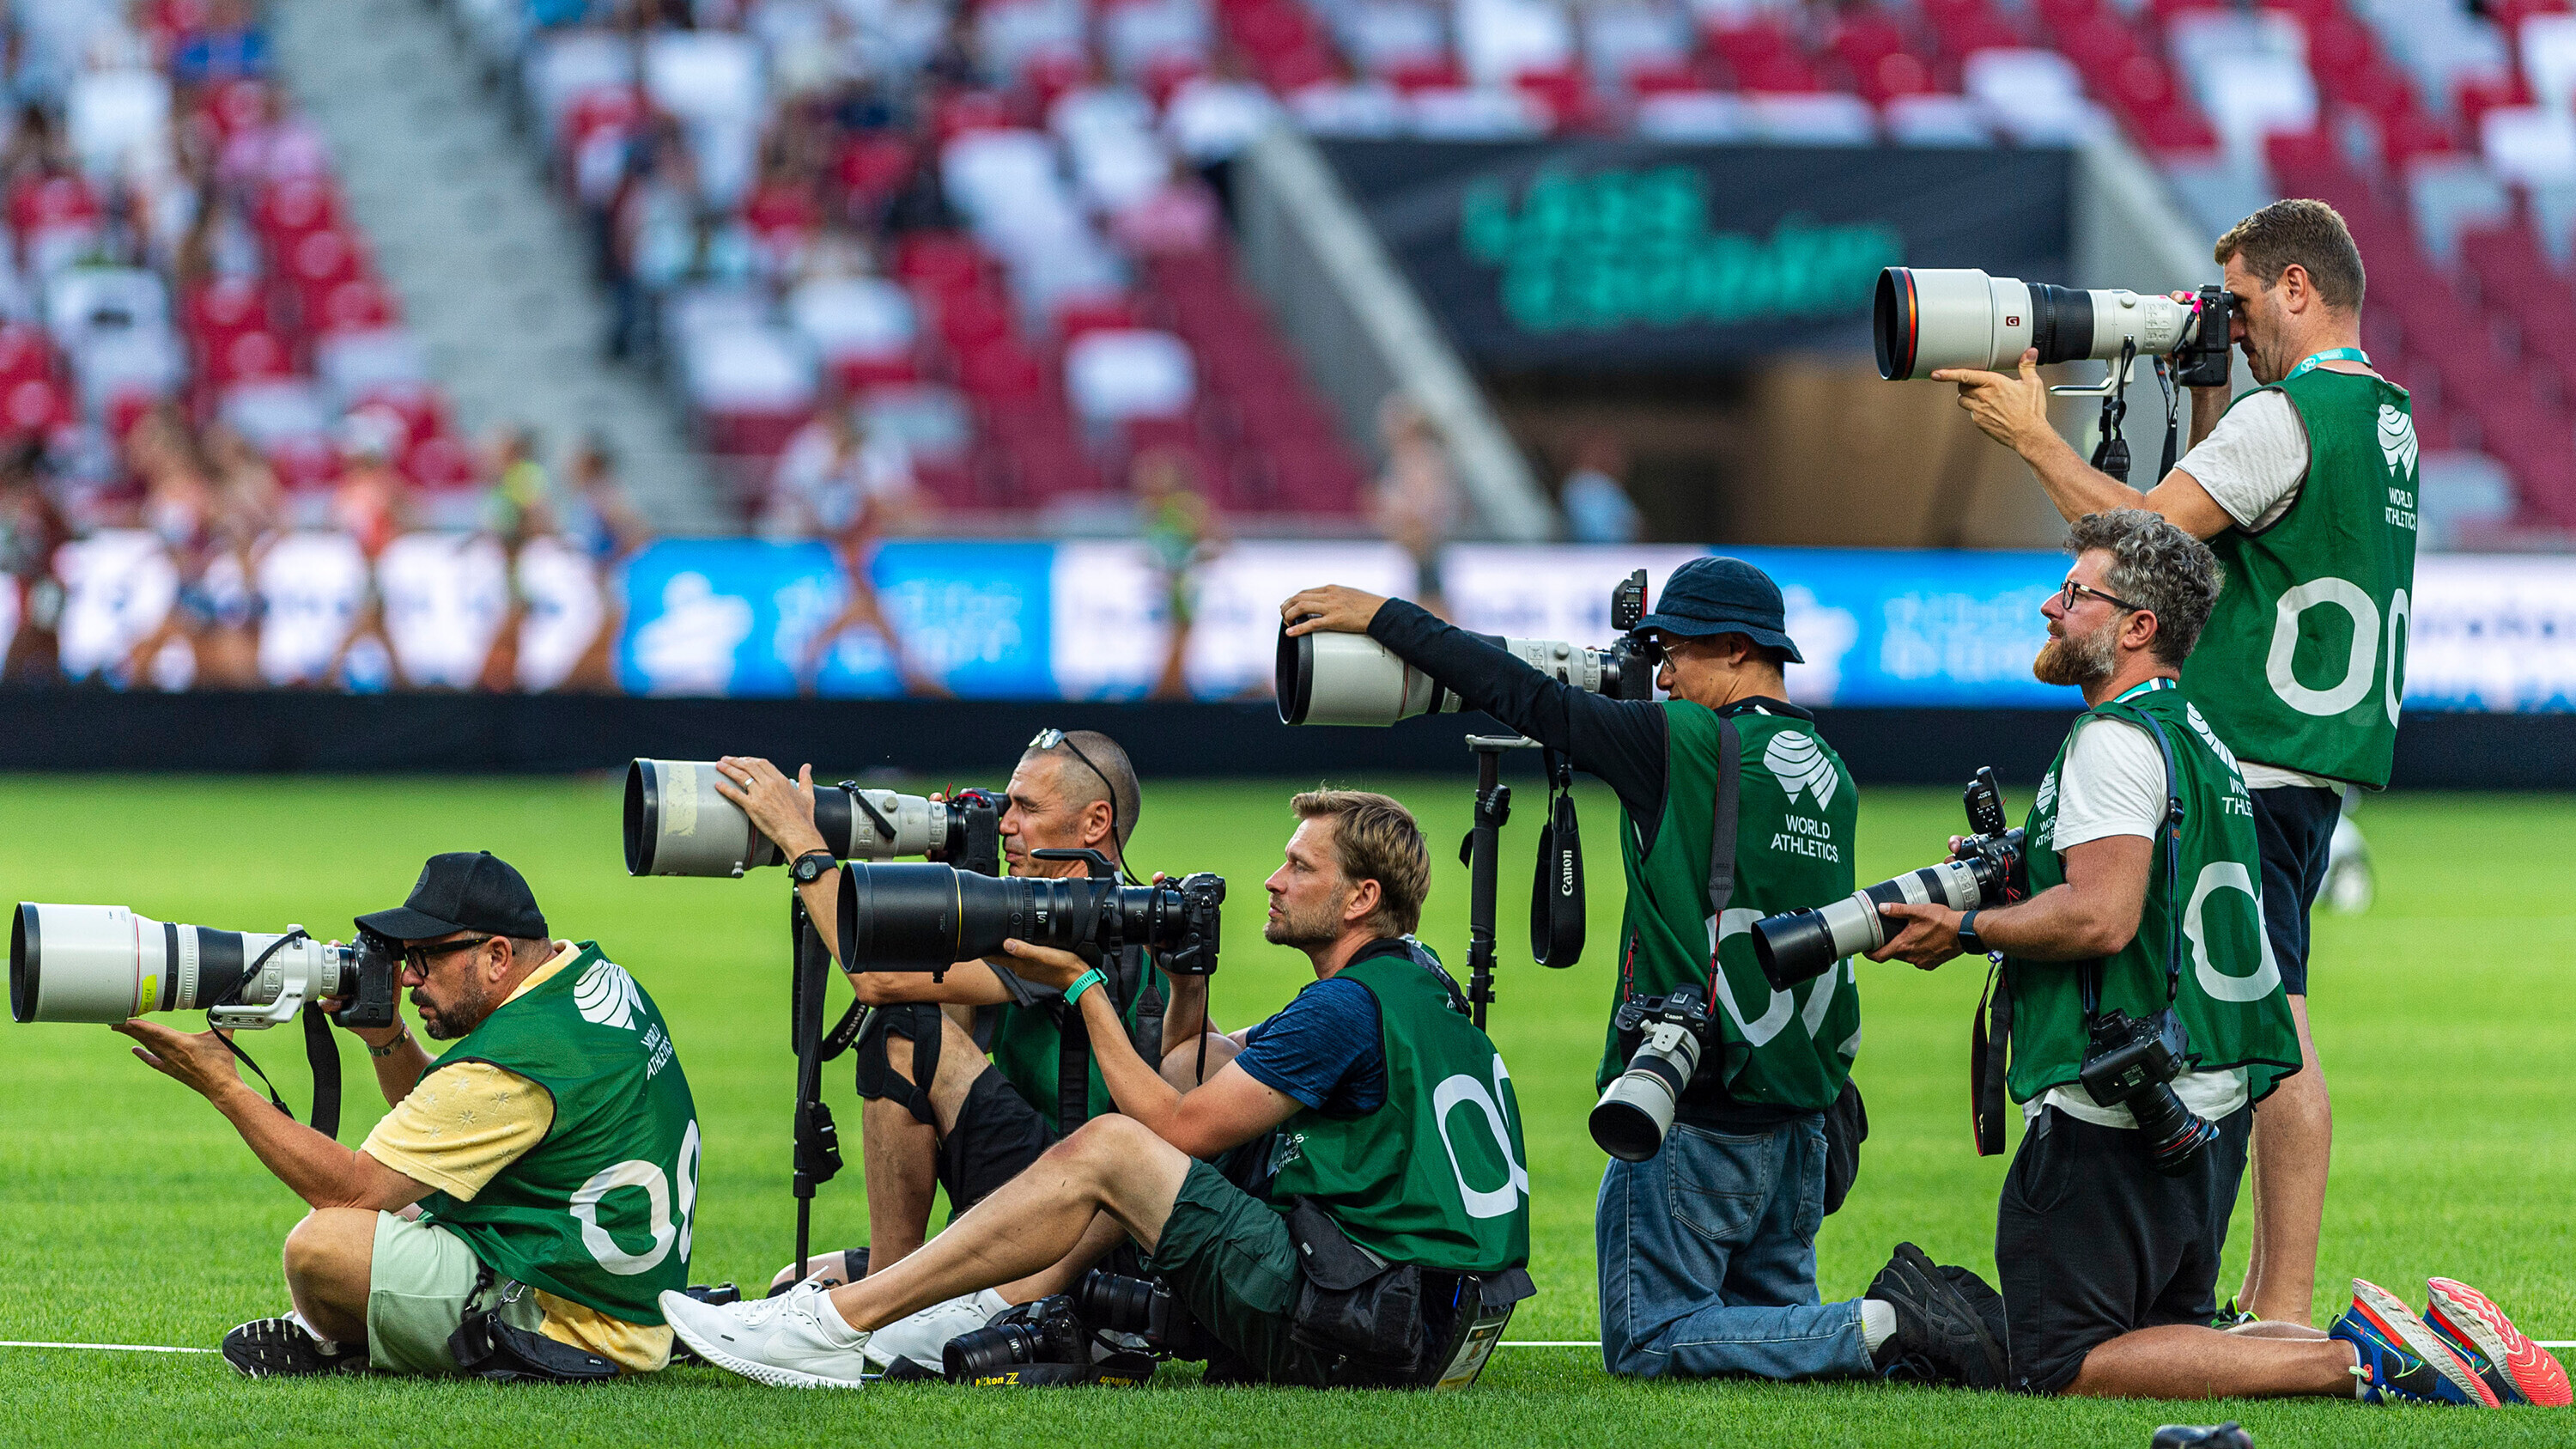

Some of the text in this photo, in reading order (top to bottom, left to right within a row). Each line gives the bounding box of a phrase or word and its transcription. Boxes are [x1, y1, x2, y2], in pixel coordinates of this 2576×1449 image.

[2008, 317, 2018, 326] G
[2389, 486, 2413, 509] WORLD
[1785, 813, 1831, 839] WORLD
[2039, 815, 2057, 831] WOR
[1771, 832, 1838, 863] ATHLETICS
[2034, 829, 2055, 849] ATHLE
[1561, 849, 1573, 897] Canon
[837, 1004, 866, 1044] Canon
[1664, 1012, 1684, 1021] Canon
[641, 1022, 661, 1053] WORLD
[647, 1036, 674, 1081] ATHLETICS
[975, 1372, 1019, 1387] Nikon Z
